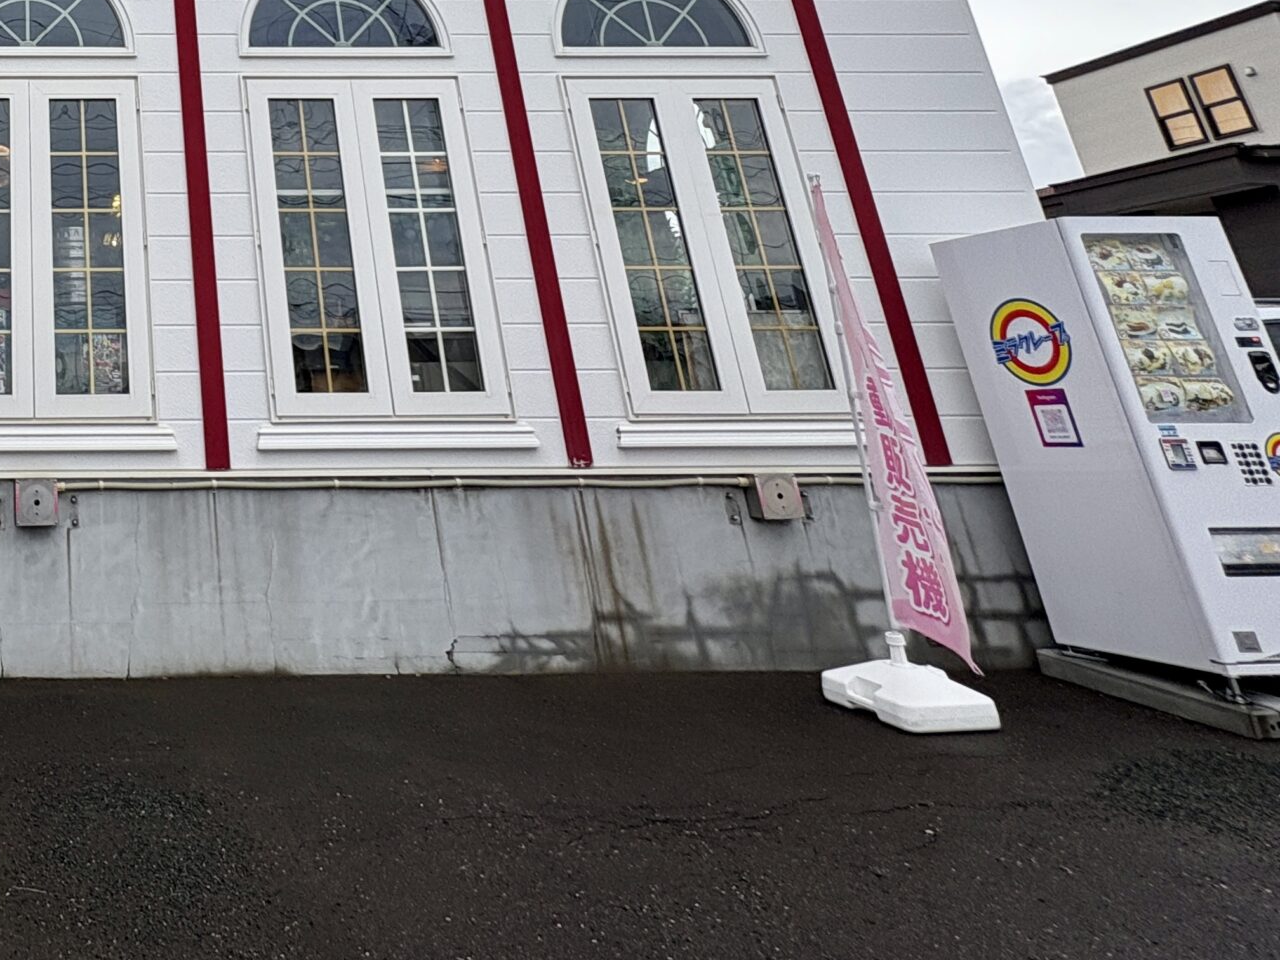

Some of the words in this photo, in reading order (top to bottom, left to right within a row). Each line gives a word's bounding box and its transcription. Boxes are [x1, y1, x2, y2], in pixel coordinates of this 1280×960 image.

[992, 320, 1071, 364] ミラクレープ
